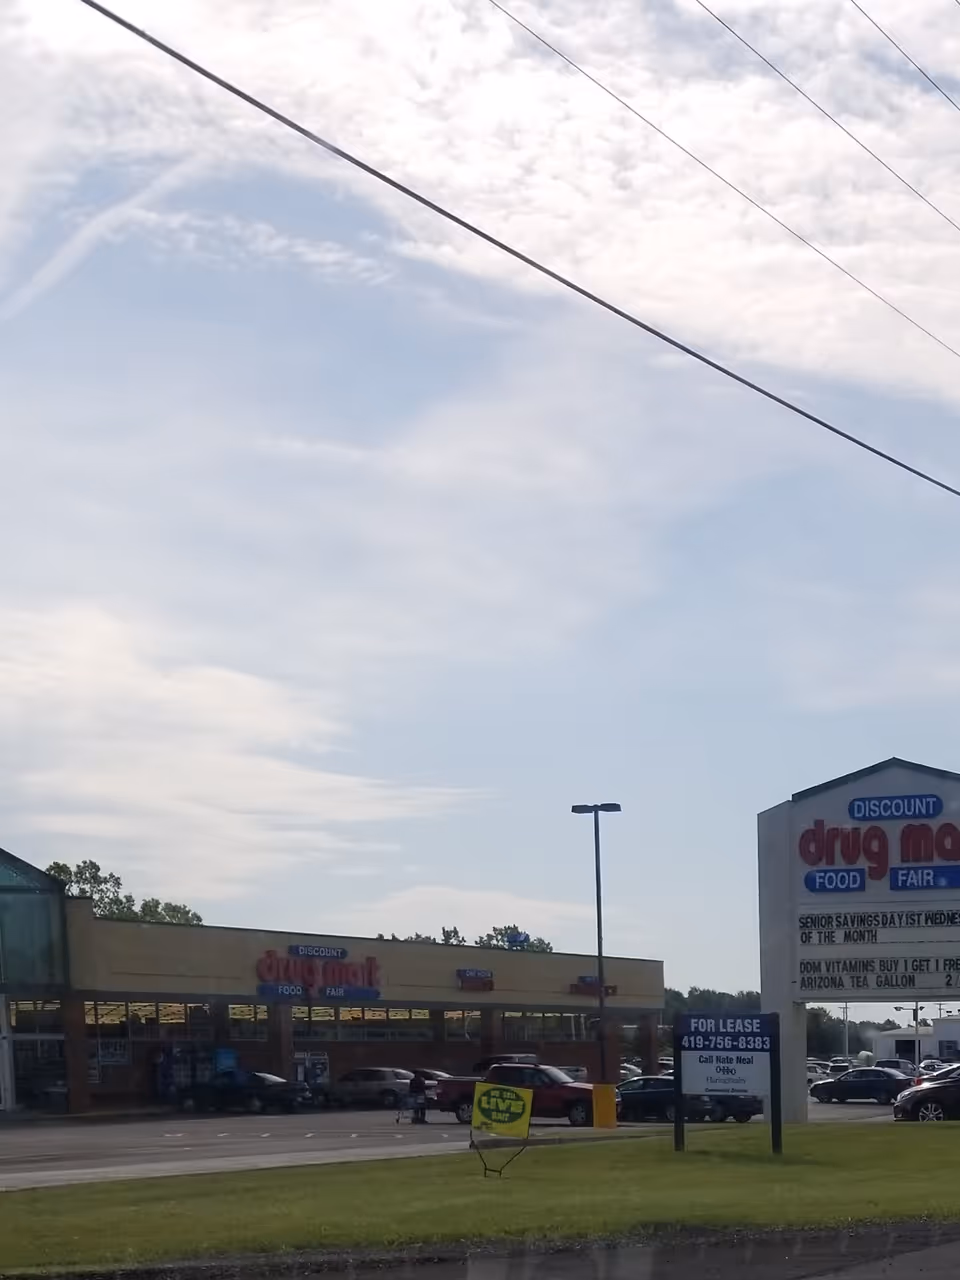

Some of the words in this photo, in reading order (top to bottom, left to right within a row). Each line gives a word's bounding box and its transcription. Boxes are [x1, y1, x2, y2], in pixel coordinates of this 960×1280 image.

[854, 798, 936, 817] DISCOUNT
[798, 819, 889, 881] drug
[815, 871, 861, 888] FOOD
[898, 870, 934, 886] FAIR
[799, 914, 834, 929] SENIOR
[835, 913, 881, 928] SAVINGS
[882, 912, 904, 927] DAY
[800, 931, 813, 944] OF
[817, 930, 835, 943] THE
[844, 929, 877, 943] MONTH
[299, 946, 342, 957] DISCOUNT
[825, 960, 876, 973] VITAMINS
[879, 959, 899, 973] BUY
[912, 959, 931, 972] GET
[800, 975, 845, 989] ARIZONA
[850, 974, 869, 988] TEA
[876, 974, 916, 988] GALLON
[279, 986, 302, 995] FOOD
[326, 987, 345, 997] FAIR
[690, 1018, 716, 1033] FOR
[719, 1018, 761, 1033] LEASE
[681, 1035, 771, 1049] 419-756-8383
[698, 1054, 714, 1065] Call
[481, 1095, 525, 1113] LIVE
